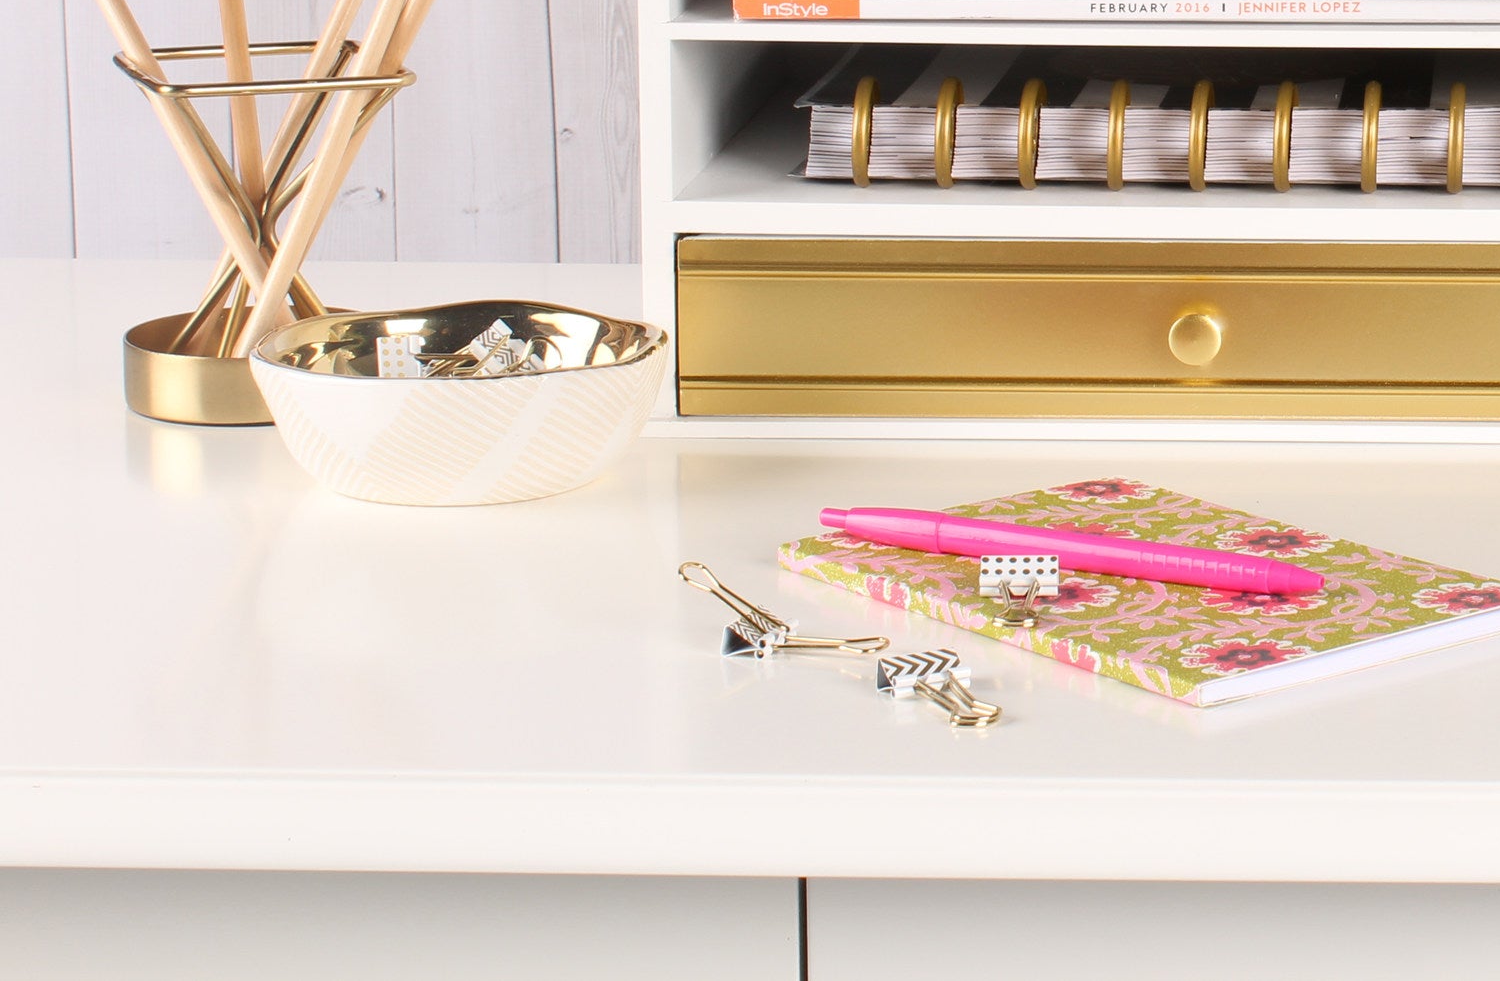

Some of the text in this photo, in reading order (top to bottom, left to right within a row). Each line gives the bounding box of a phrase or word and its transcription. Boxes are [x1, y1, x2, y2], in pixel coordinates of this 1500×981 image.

[763, 3, 829, 17] InStyle
[1090, 3, 1169, 13] FEBRUARY
[1175, 3, 1210, 13] 2016
[1238, 2, 1306, 15] JENNIFER
[1312, 2, 1361, 13] LOPEZ
